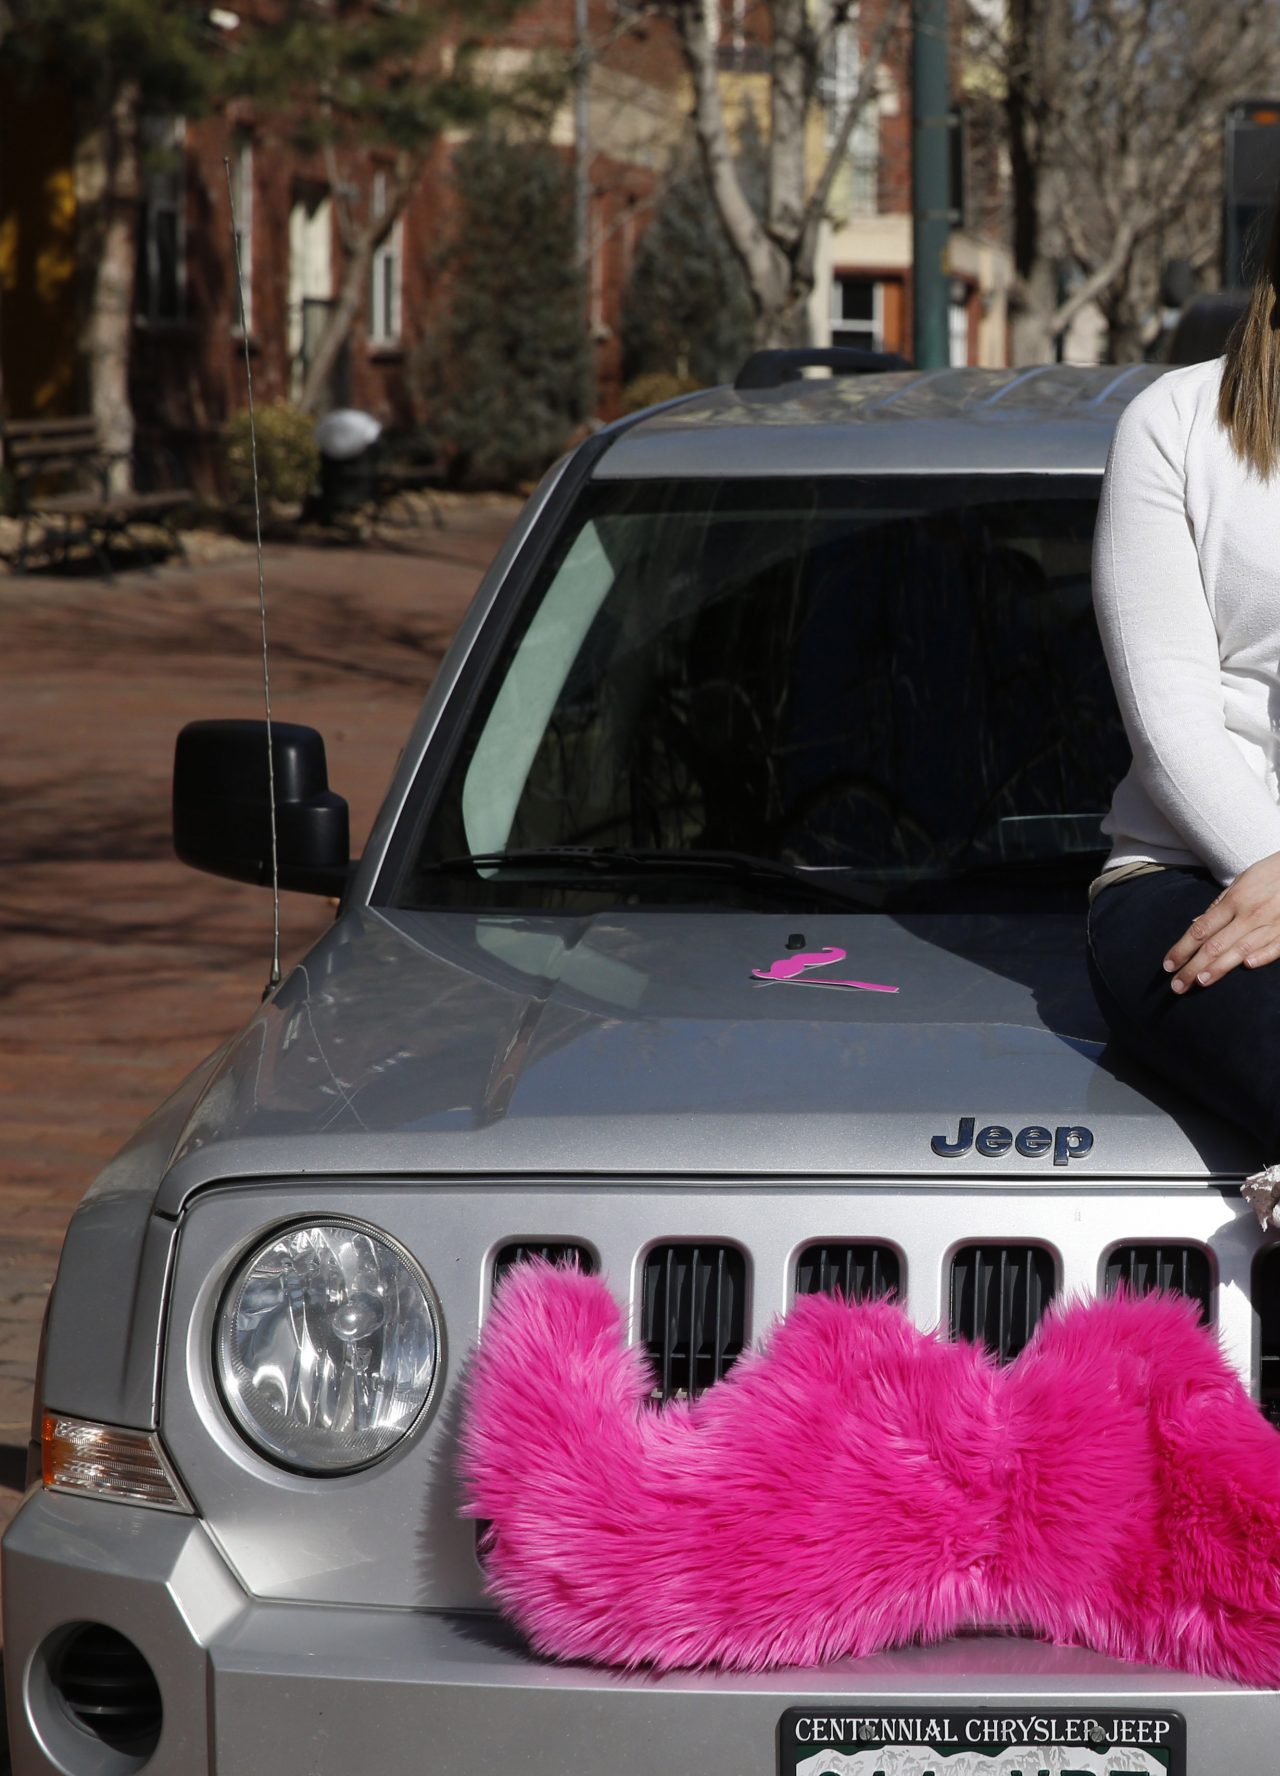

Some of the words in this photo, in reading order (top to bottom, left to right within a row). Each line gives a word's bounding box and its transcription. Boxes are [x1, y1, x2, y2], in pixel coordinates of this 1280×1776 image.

[930, 1117, 1094, 1167] Jeep
[795, 1717, 959, 1742] CENTENNIAL
[1105, 1719, 1170, 1743] JEEP
